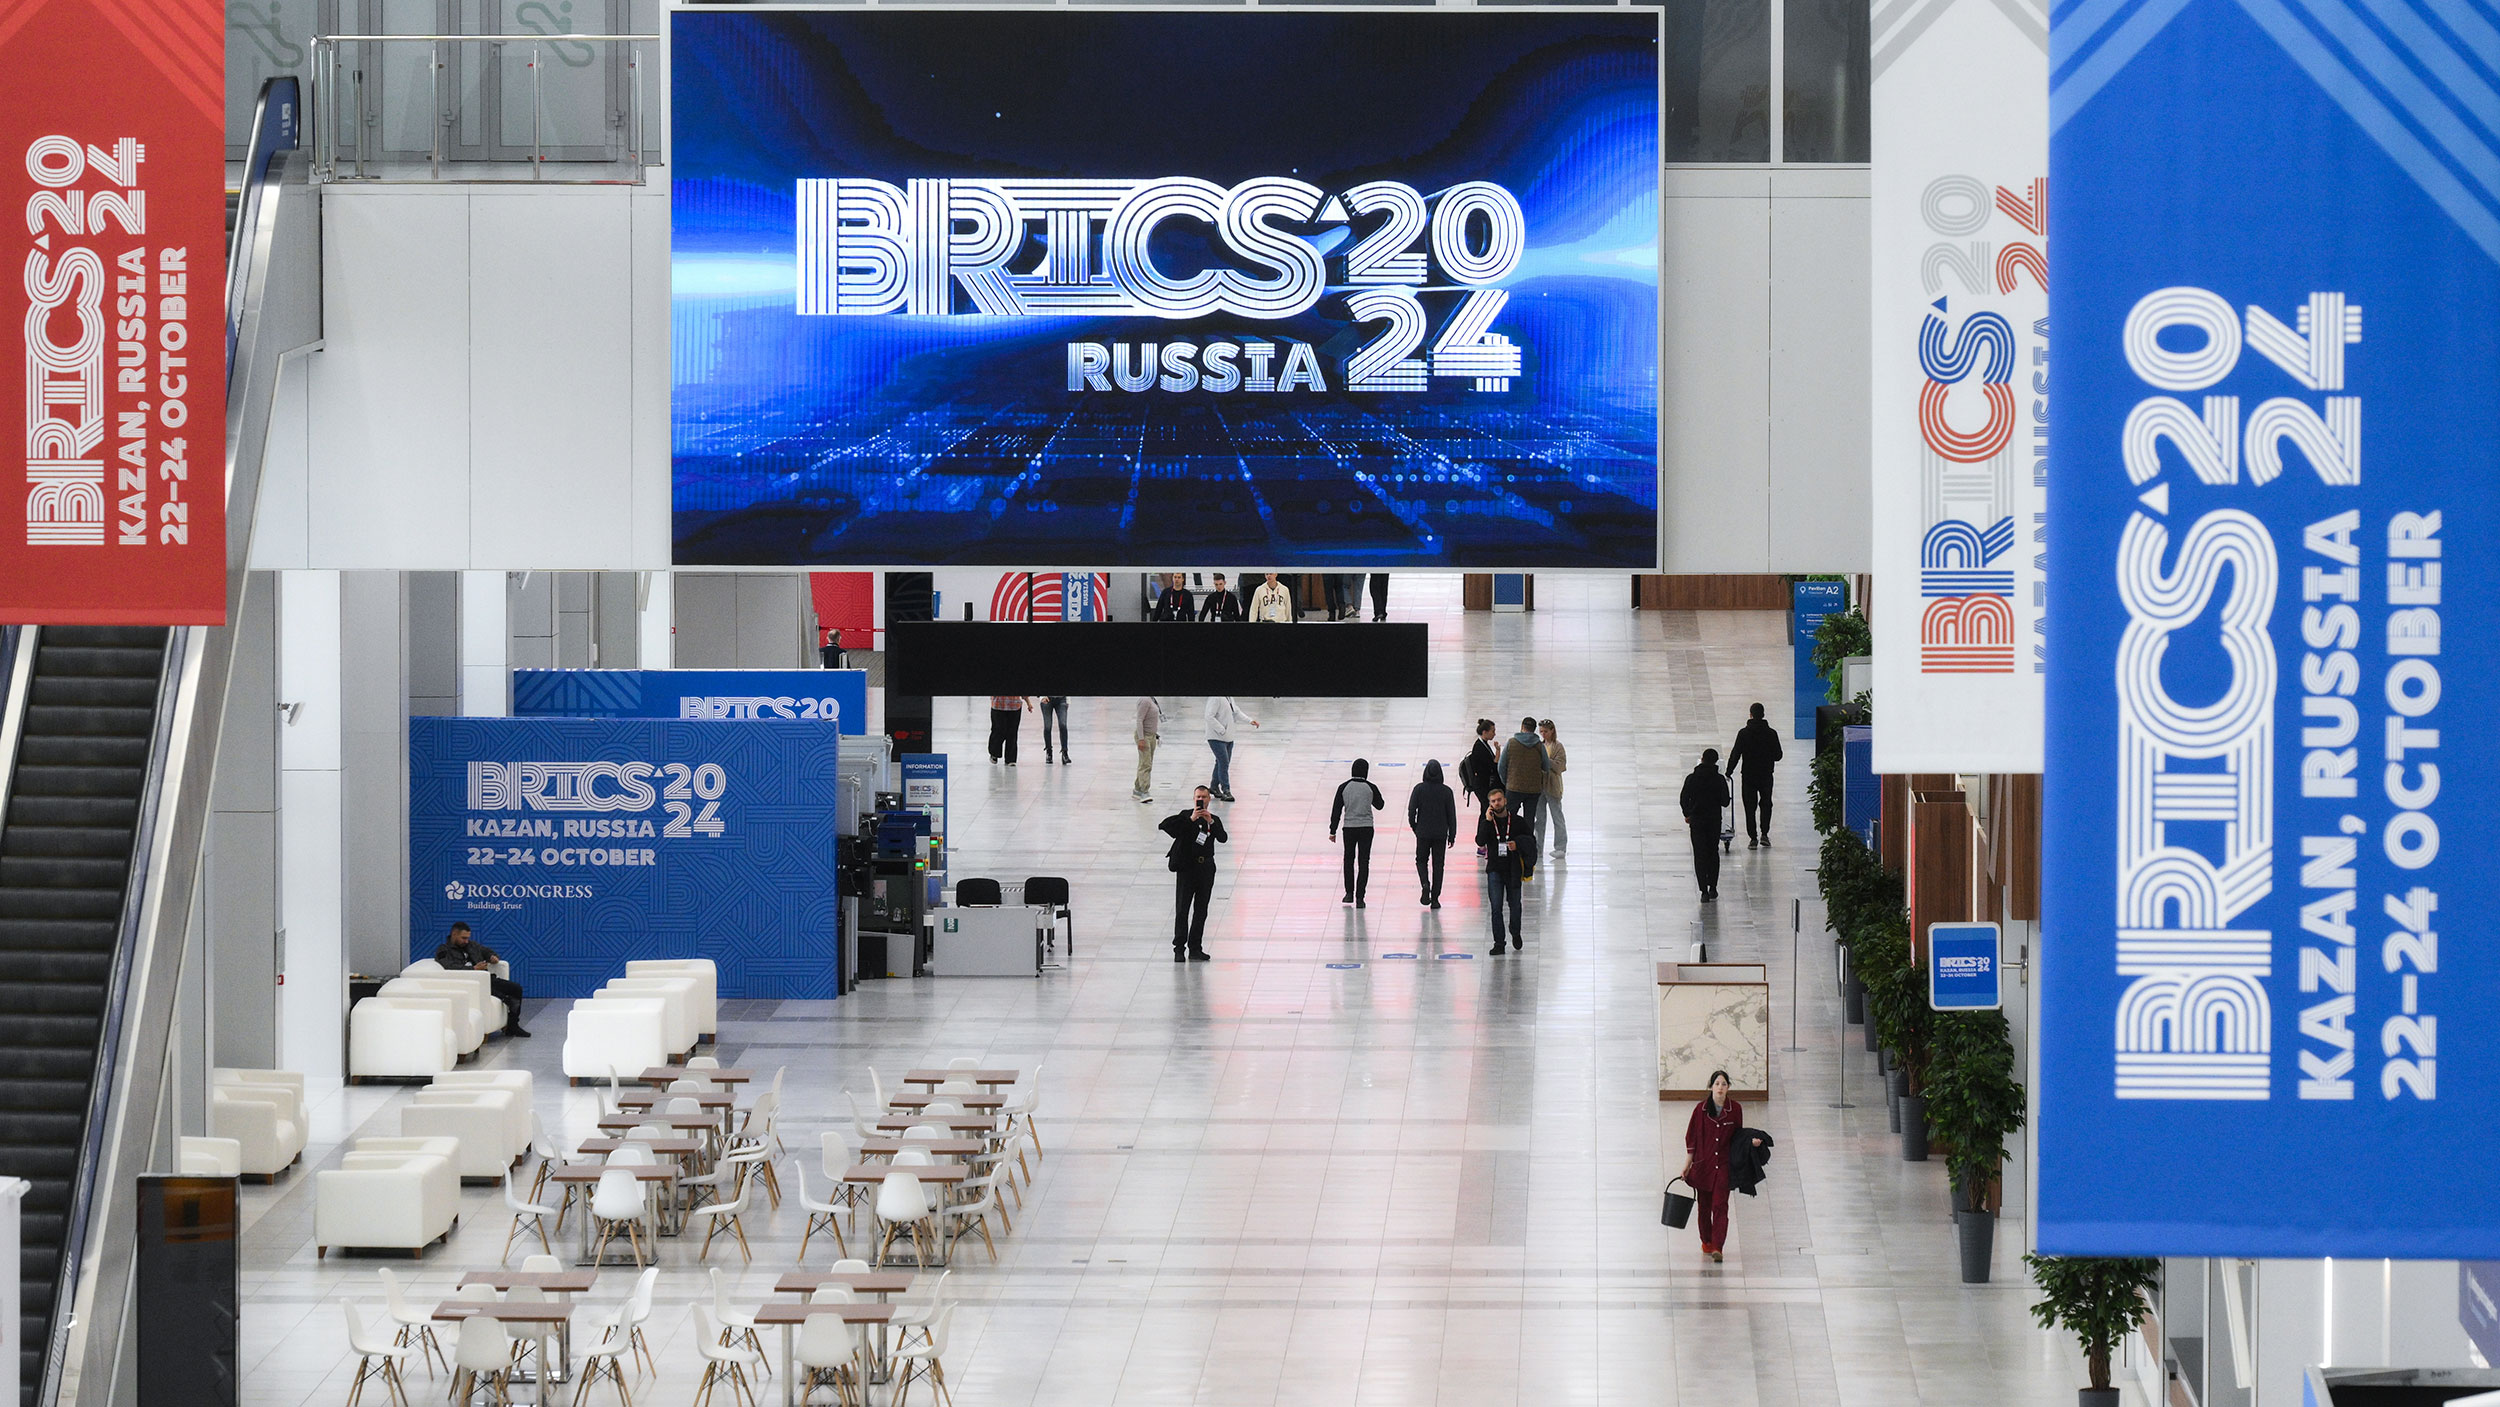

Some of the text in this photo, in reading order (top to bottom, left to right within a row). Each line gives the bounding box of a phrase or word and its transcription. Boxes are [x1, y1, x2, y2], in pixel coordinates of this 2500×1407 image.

[87, 136, 146, 235] 24
[796, 176, 1525, 319] BRICS 20
[24, 135, 105, 545] BRICS 20
[160, 247, 188, 428] OCTOBER
[1067, 289, 1521, 393] RUSSIA 24
[117, 247, 150, 545] KAZAN, RUSSIA
[1918, 175, 2016, 674] BRICS 20
[2244, 291, 2362, 487] 24
[1263, 594, 1284, 606] GAP
[1825, 586, 1839, 594] A2
[800, 697, 840, 719] 20
[2115, 286, 2279, 1100] BRICS 20
[2383, 510, 2442, 870] OCTOBER
[467, 761, 726, 812] BRICS 20
[467, 819, 656, 840] KAZAN, RUSSIA
[662, 801, 725, 838] 24
[2299, 509, 2367, 1101] KAZAN, RUSSIA
[467, 884, 593, 898] ROSCONGRESS
[467, 901, 522, 911] Building Trust
[541, 848, 656, 866] OCTOBER
[1940, 957, 1990, 967] BRICS 20
